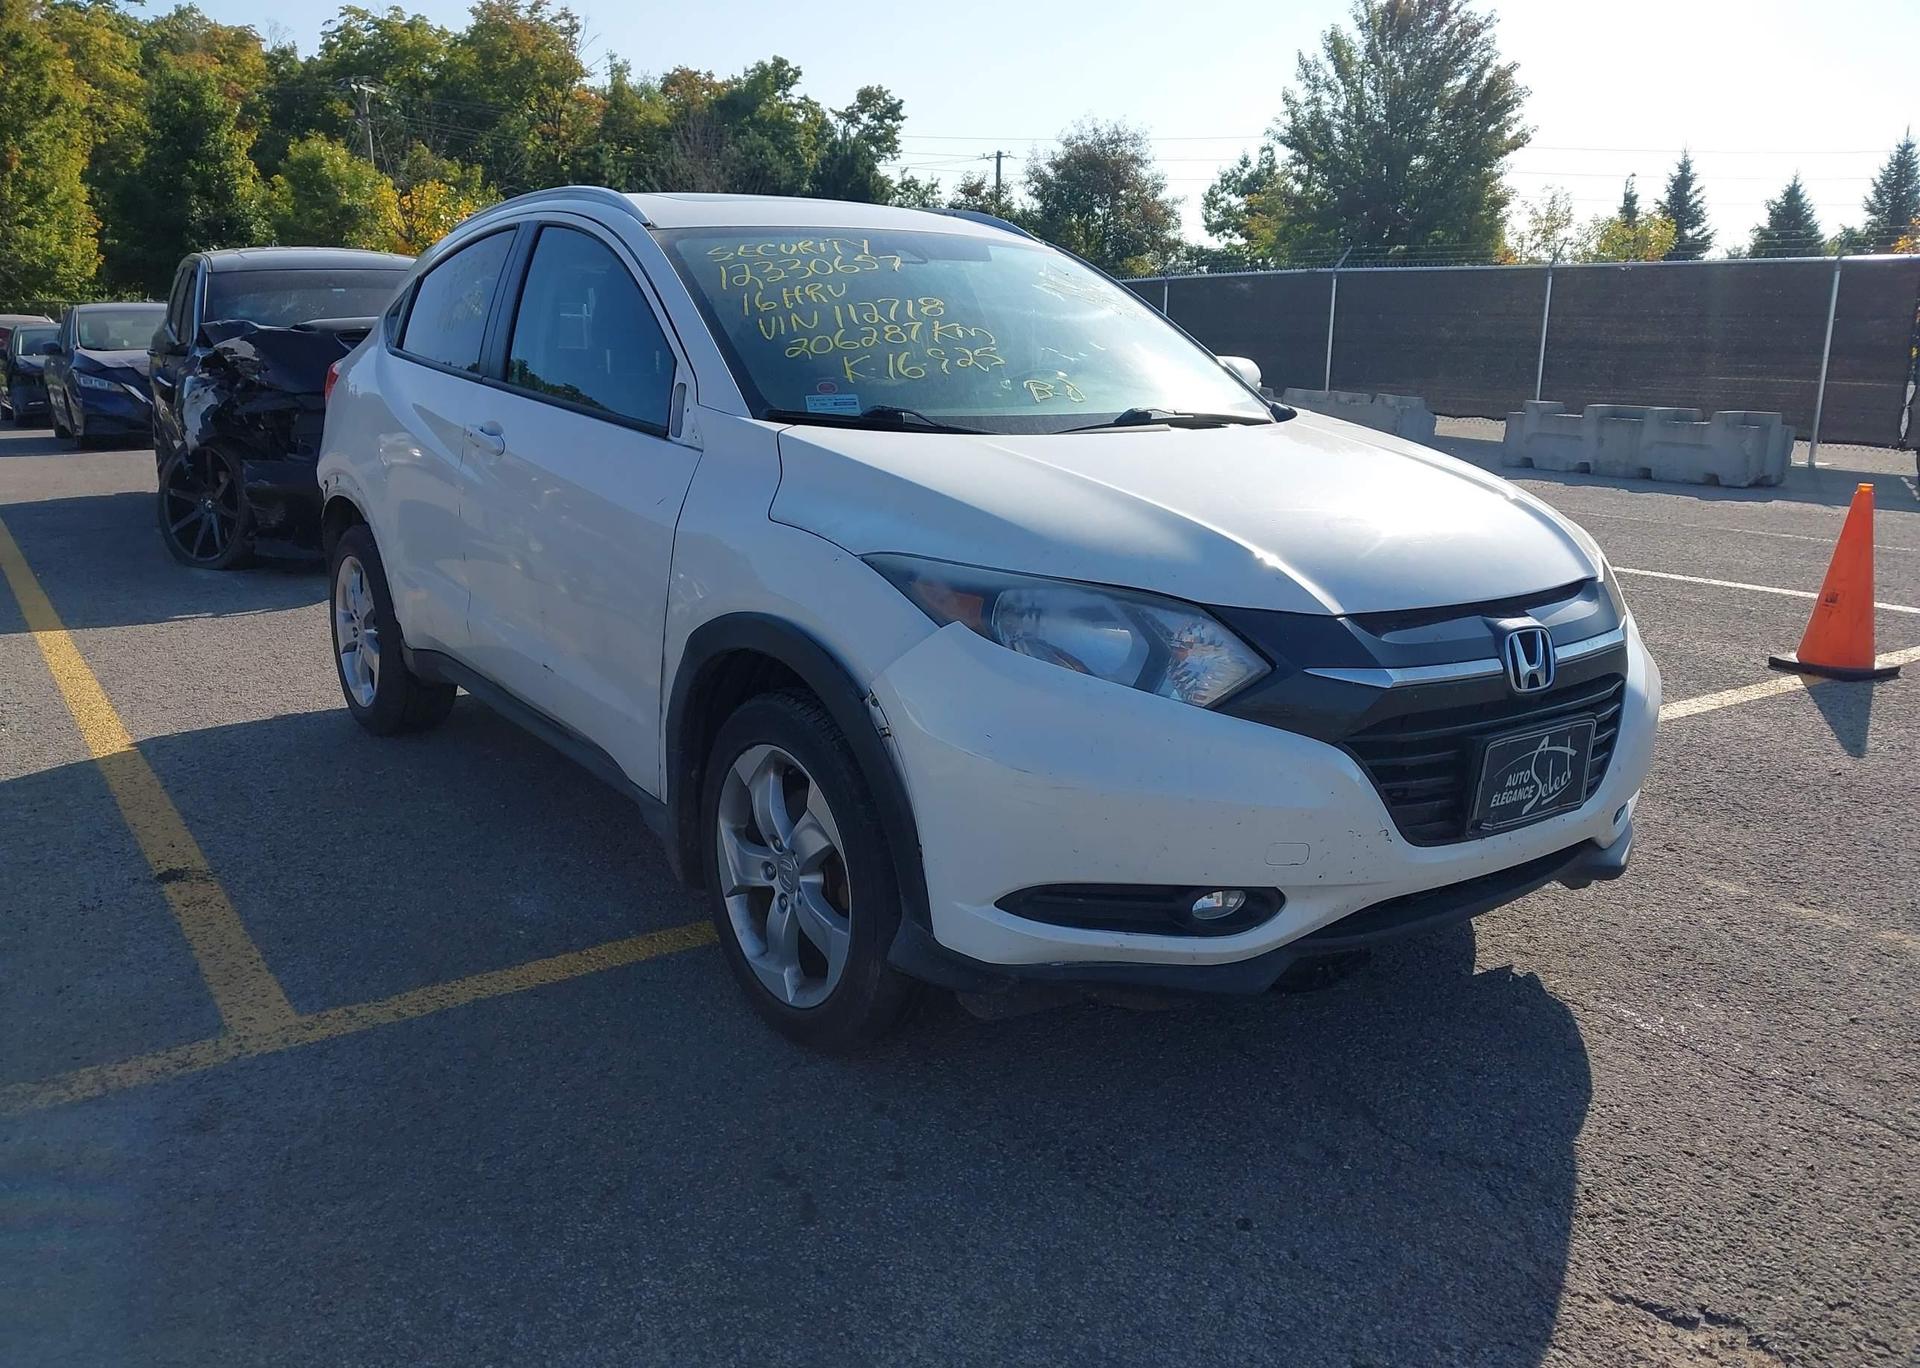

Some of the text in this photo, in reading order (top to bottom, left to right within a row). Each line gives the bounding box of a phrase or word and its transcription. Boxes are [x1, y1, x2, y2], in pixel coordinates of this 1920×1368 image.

[707, 238, 869, 262] SECURITY
[743, 290, 777, 317] 16
[758, 297, 945, 341] VIN 112718
[785, 321, 922, 361] 206287
[1505, 769, 1531, 788] AUTO
